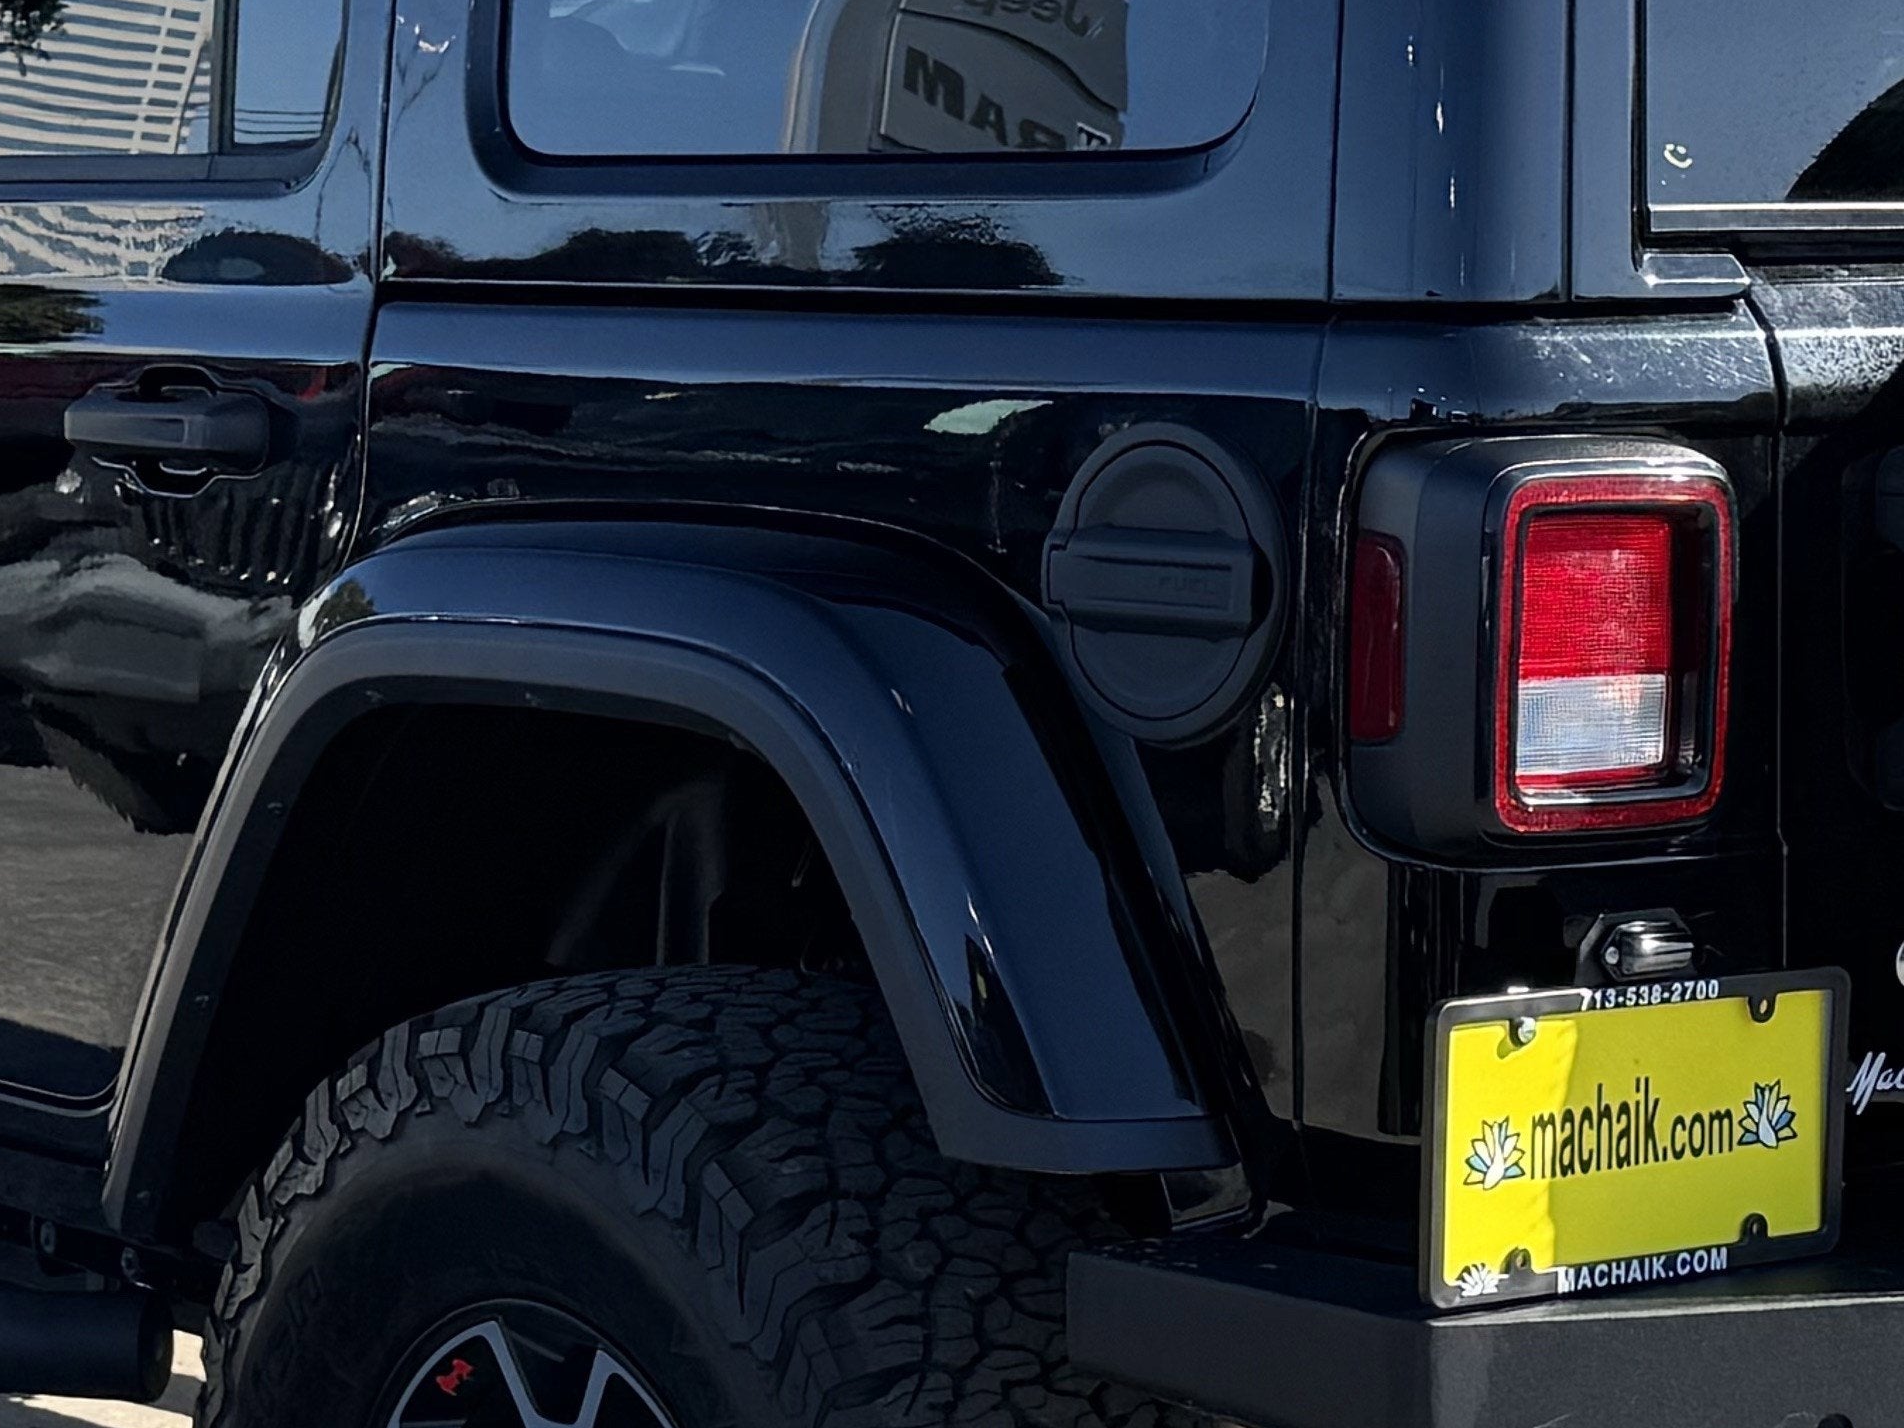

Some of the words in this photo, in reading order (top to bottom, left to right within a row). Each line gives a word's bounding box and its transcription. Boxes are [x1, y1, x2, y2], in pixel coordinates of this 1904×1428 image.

[1578, 979, 1719, 1012] 713-538-2700
[1530, 1077, 1734, 1181] machaik.com
[1557, 1246, 1728, 1294] MACHAIK.COM
